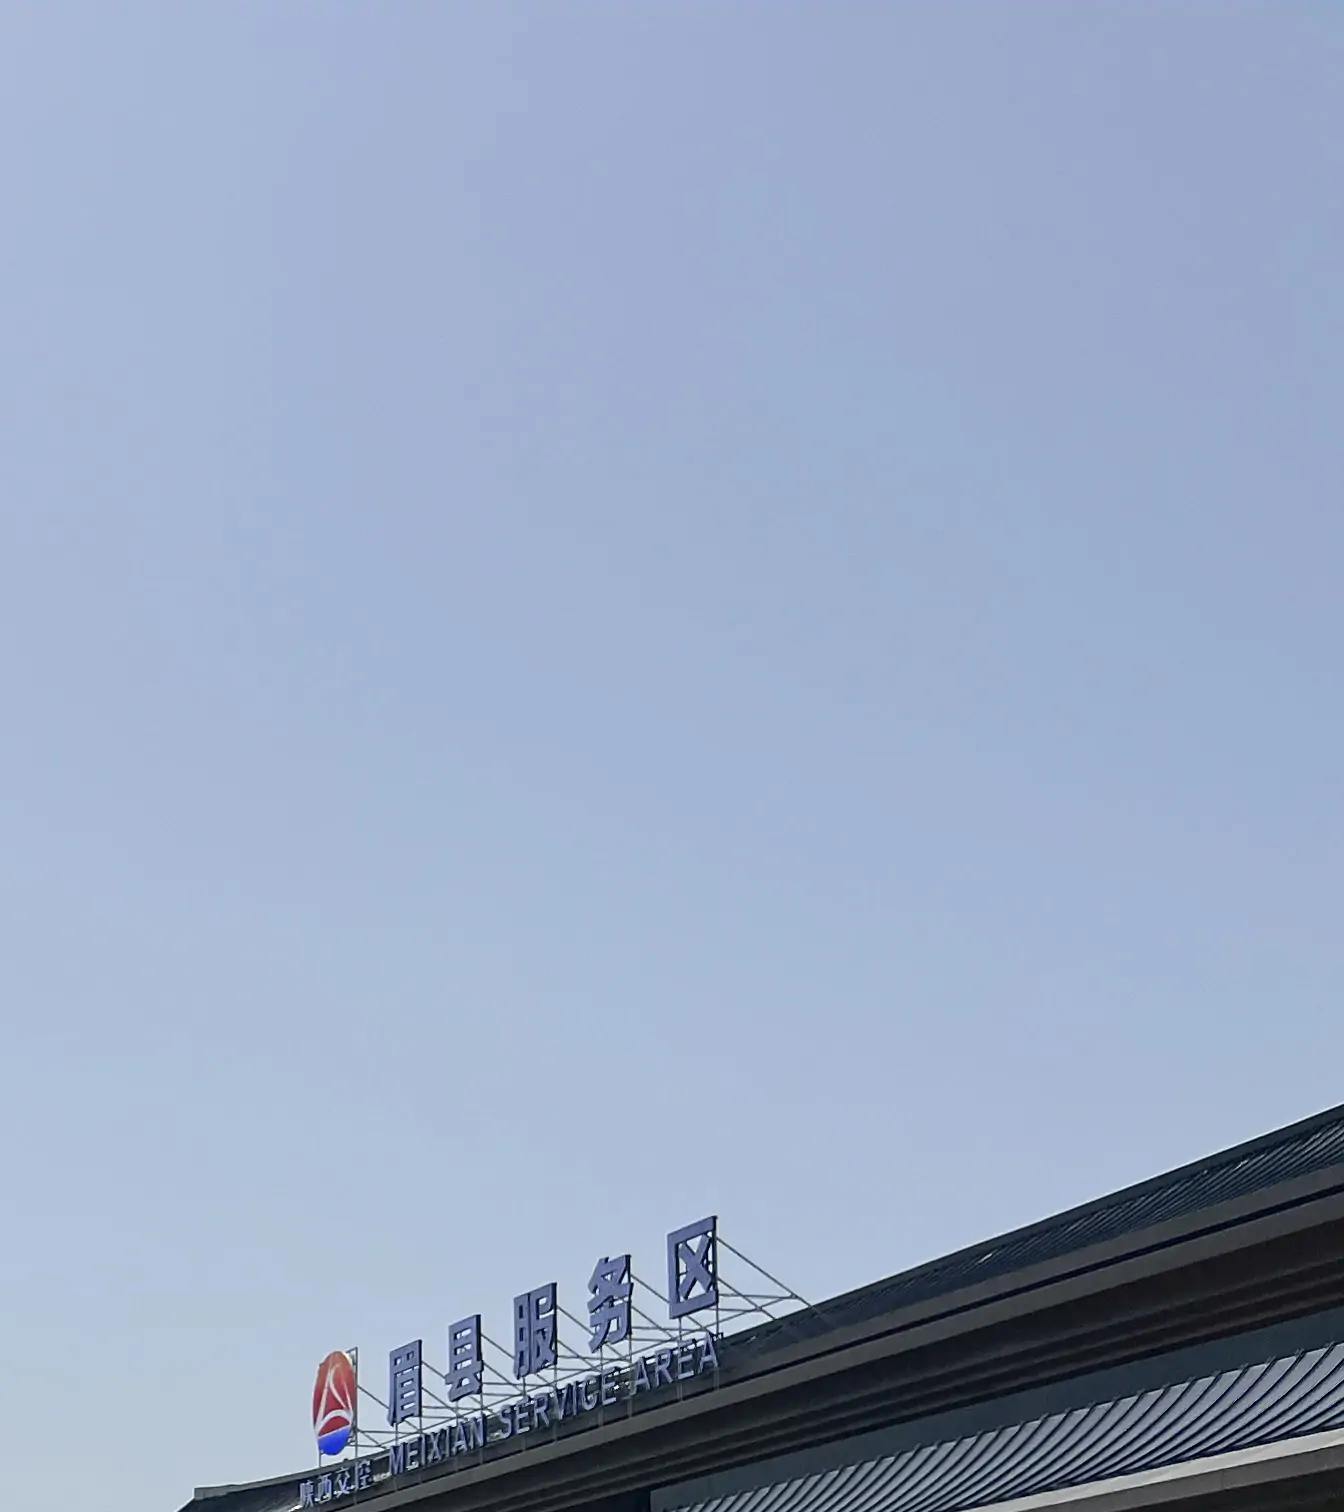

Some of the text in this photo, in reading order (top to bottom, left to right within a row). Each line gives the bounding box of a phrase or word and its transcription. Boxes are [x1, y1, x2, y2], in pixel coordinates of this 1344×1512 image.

[387, 1215, 719, 1427] 眉县服务区
[389, 1411, 487, 1475] MEIXIAN
[499, 1365, 620, 1439] SERVICE
[628, 1331, 722, 1396] AREA
